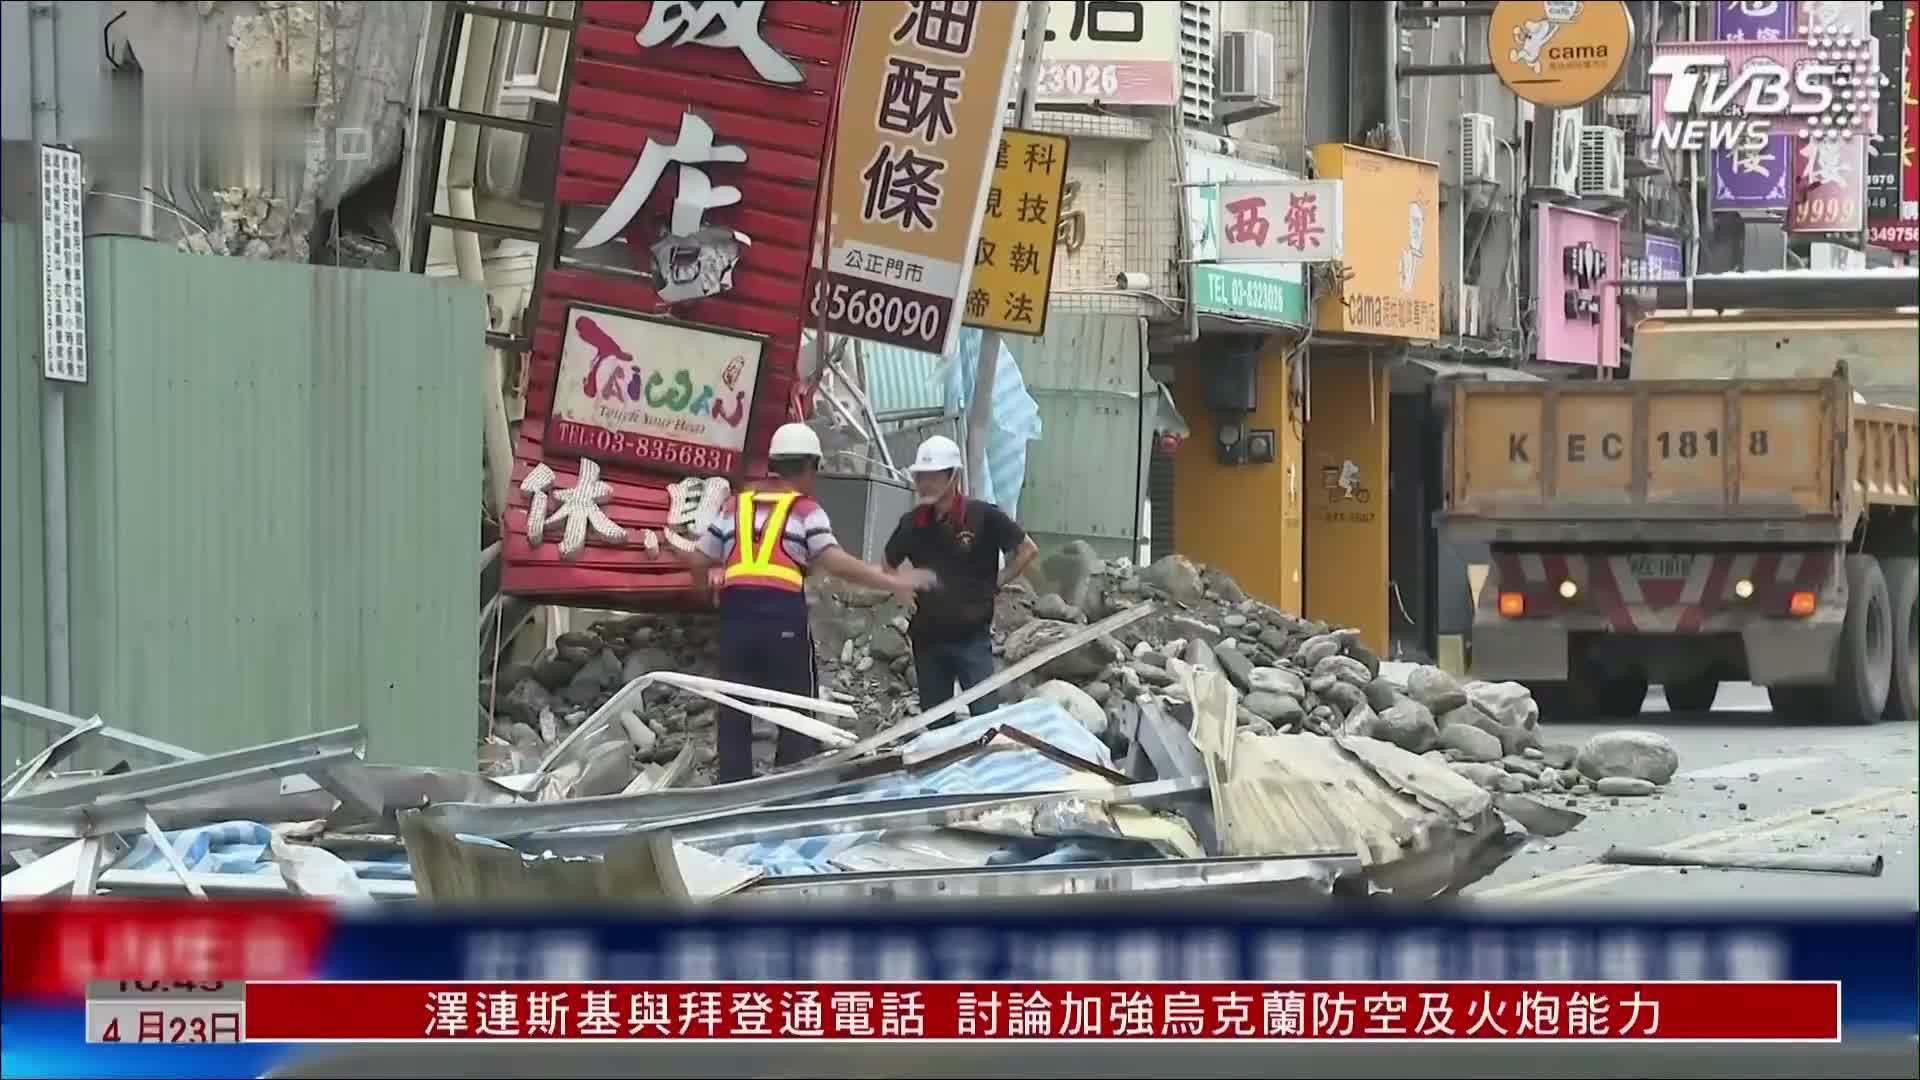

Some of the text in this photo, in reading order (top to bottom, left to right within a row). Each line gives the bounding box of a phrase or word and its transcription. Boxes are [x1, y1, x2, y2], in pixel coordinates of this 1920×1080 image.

[1549, 45, 1608, 60] cama
[1003, 143, 1056, 324] 科技執法
[1225, 192, 1325, 251] 西藥
[845, 249, 924, 282] 公正門市
